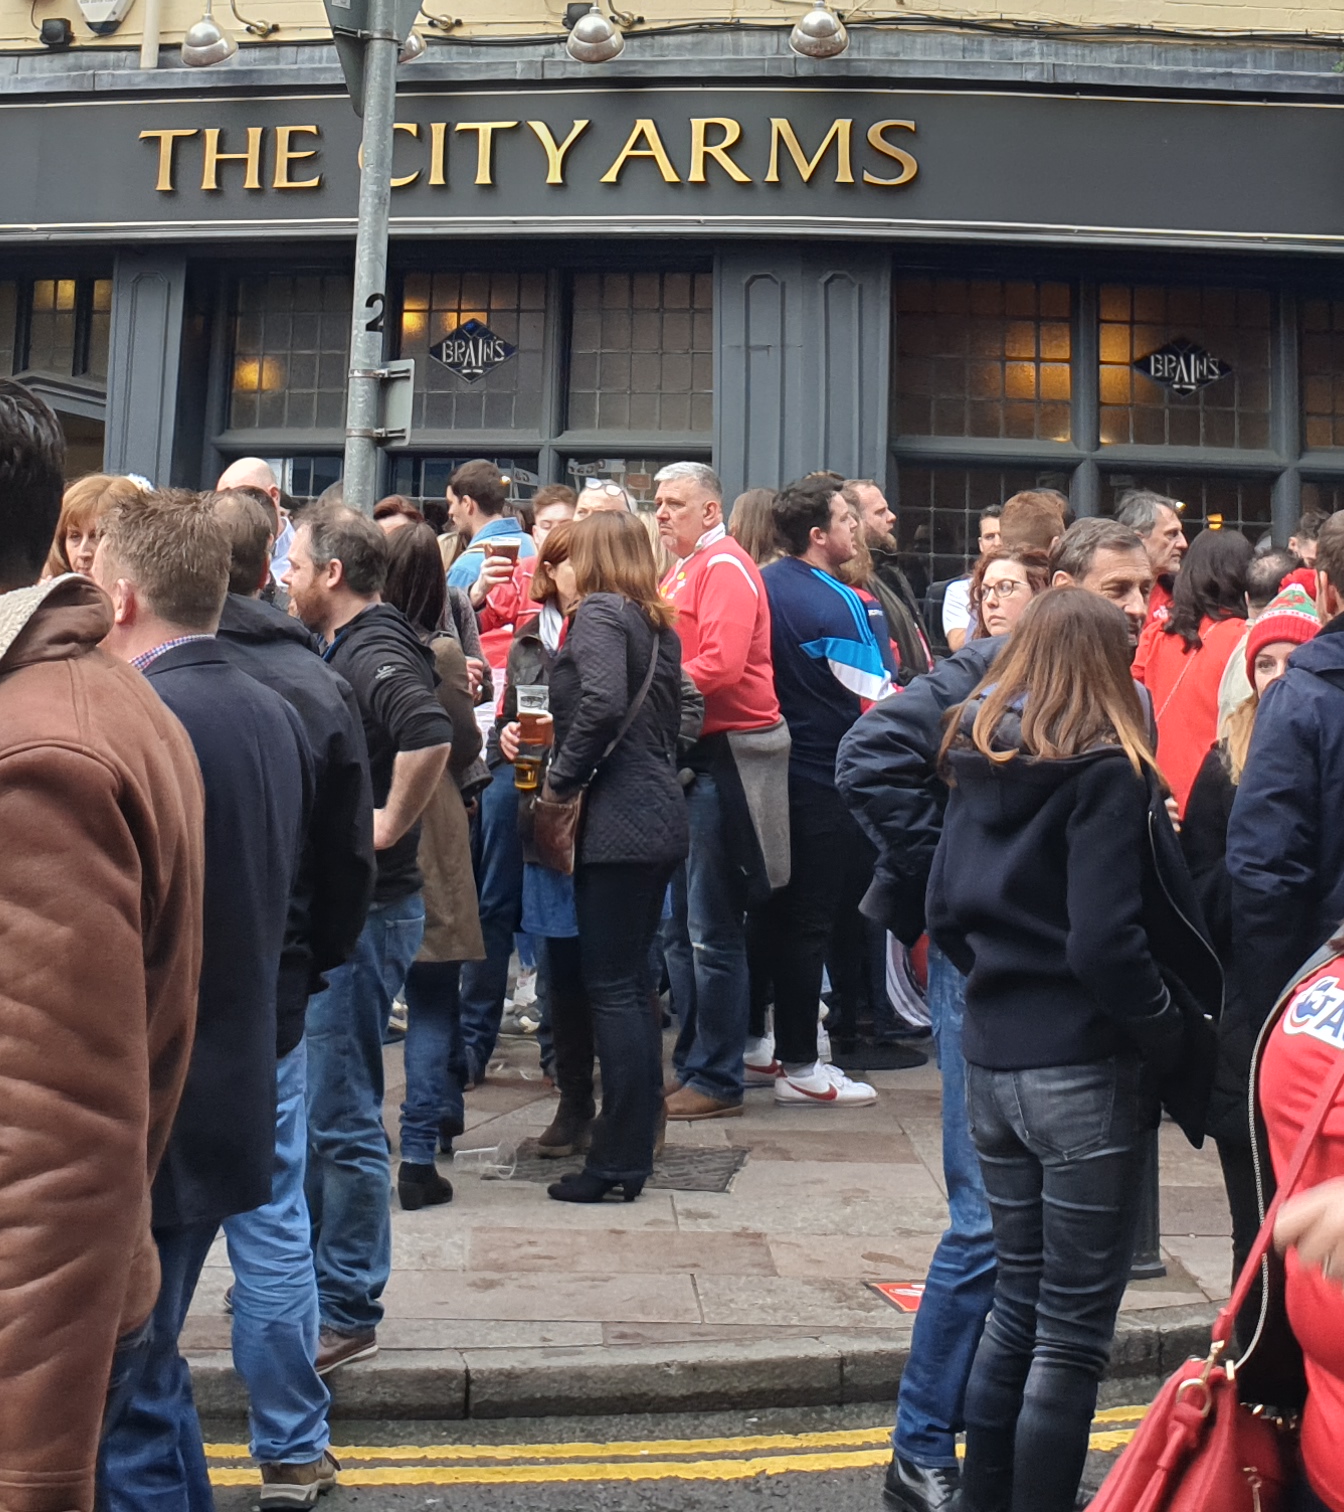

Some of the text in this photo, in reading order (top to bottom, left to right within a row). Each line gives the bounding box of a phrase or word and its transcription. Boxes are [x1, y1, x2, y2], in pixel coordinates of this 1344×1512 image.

[138, 117, 920, 191] THE CITY ARMS
[365, 293, 386, 333] 2
